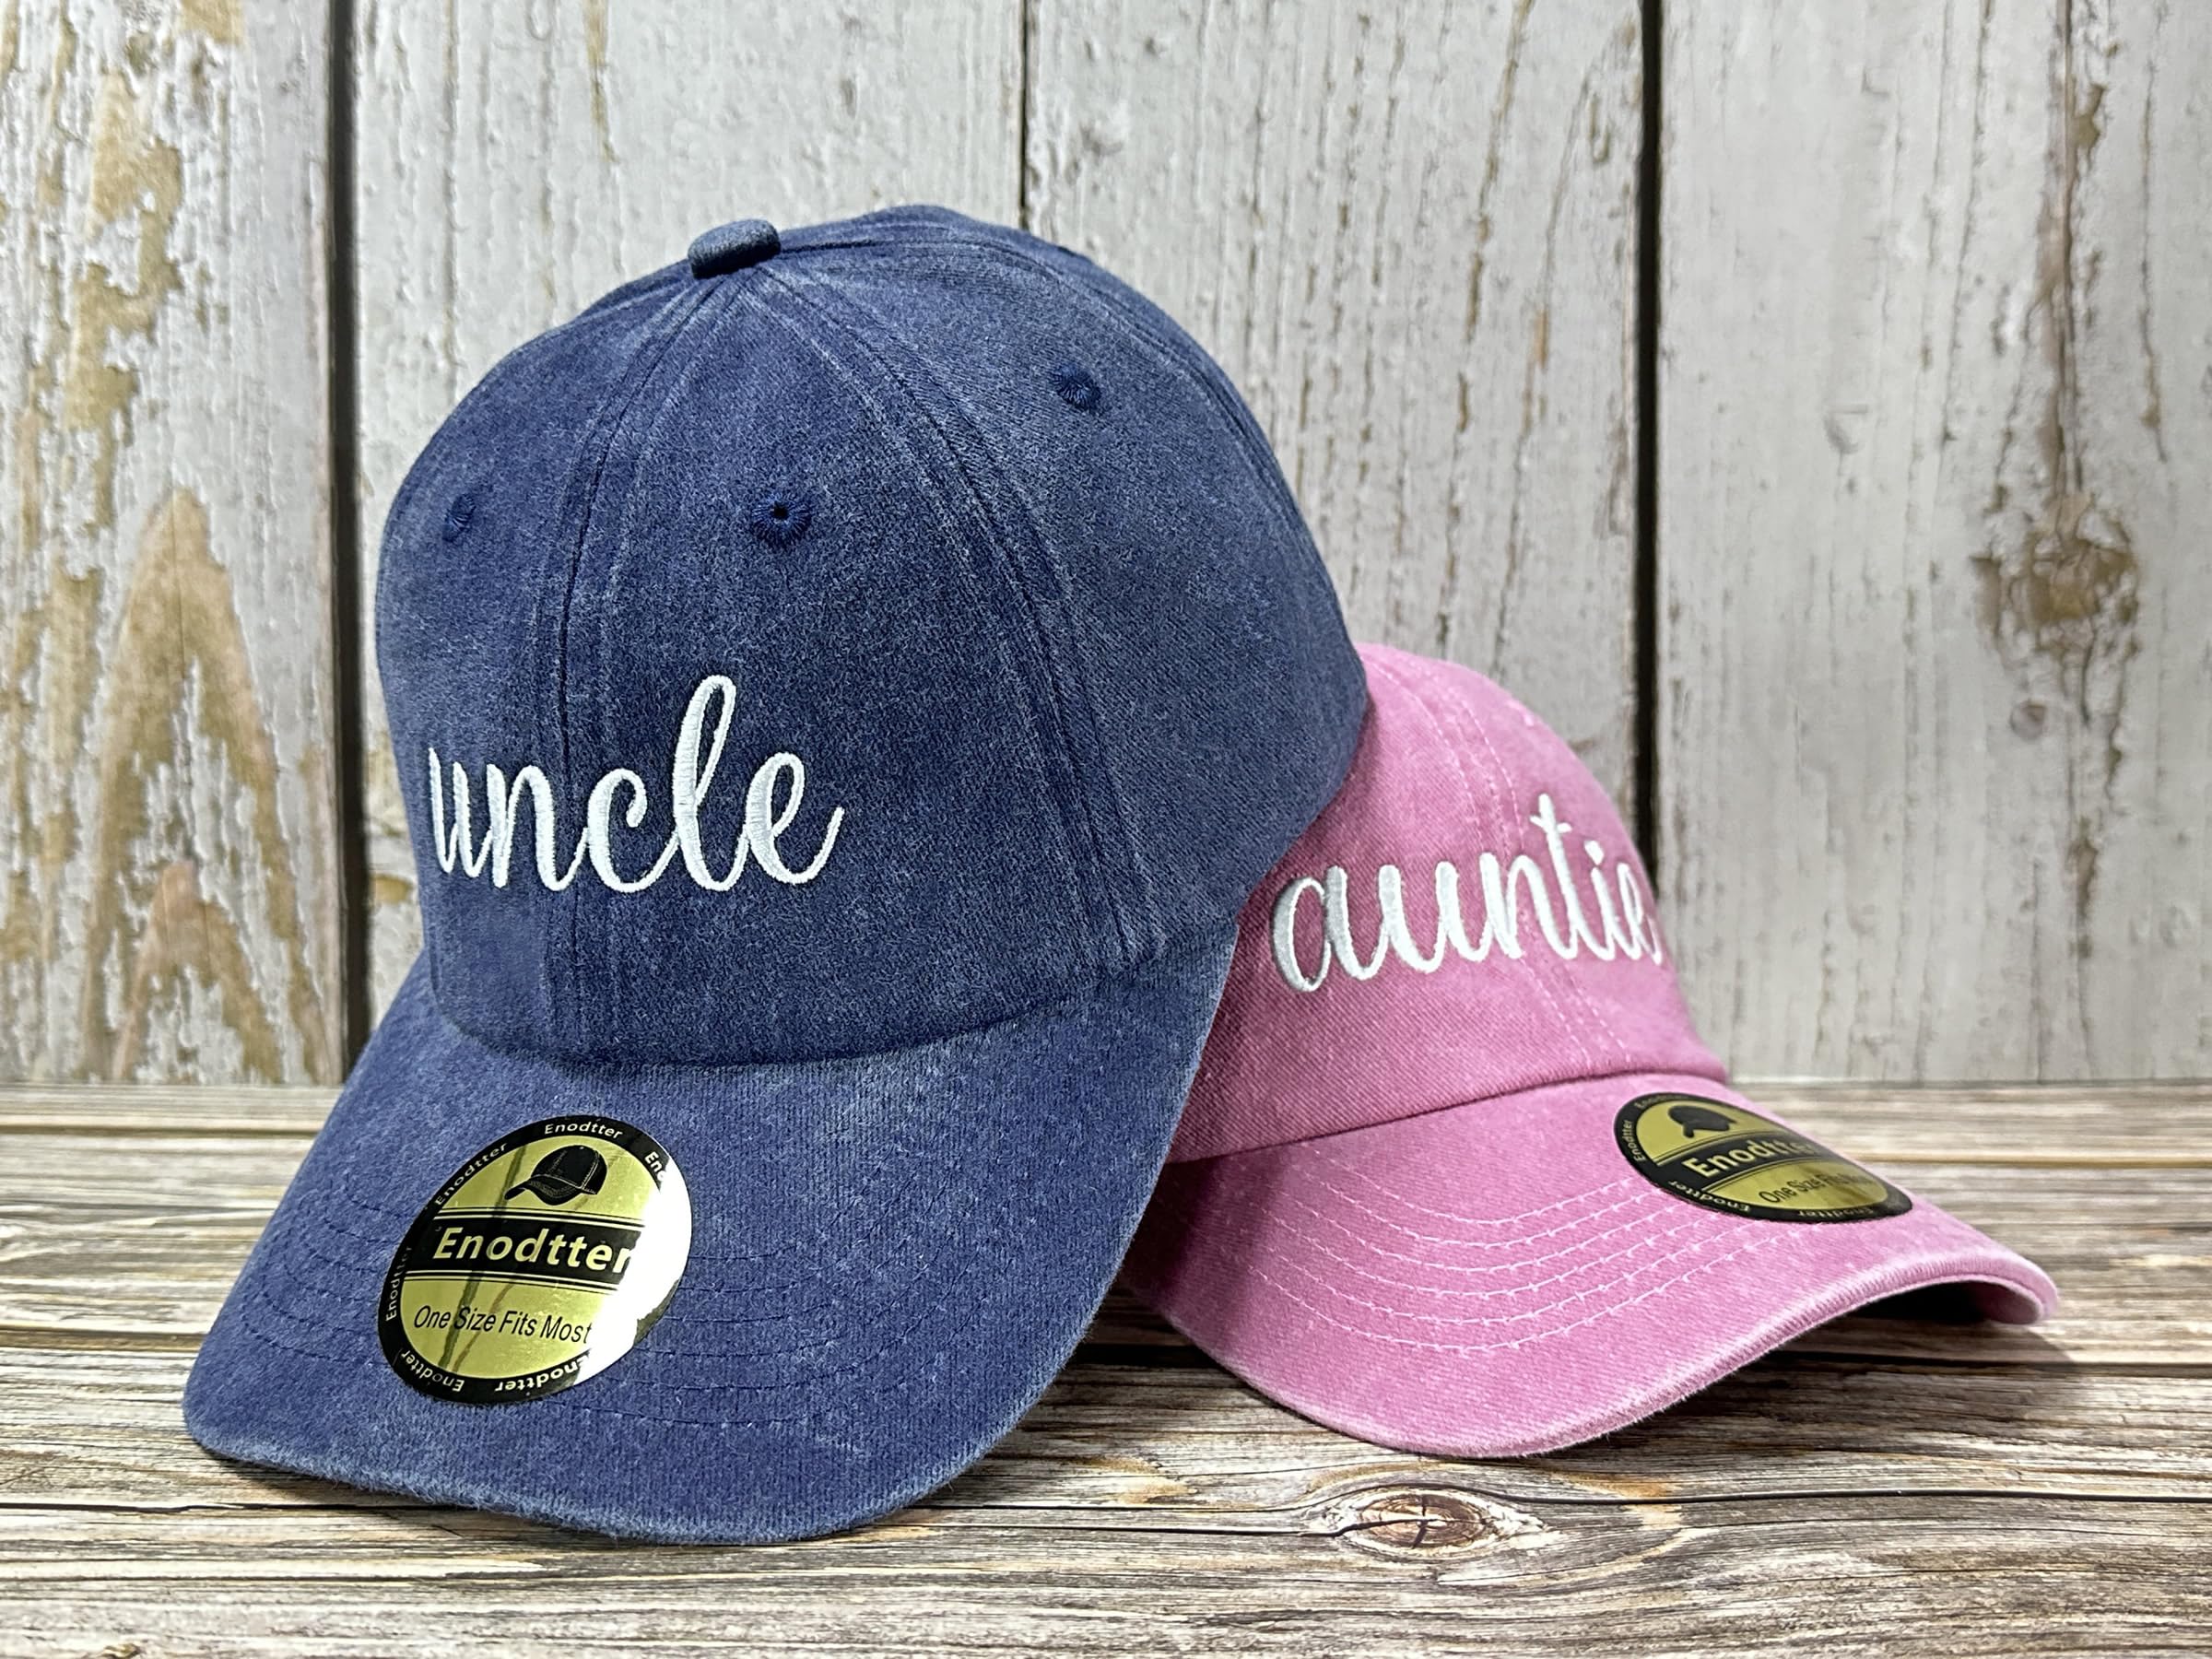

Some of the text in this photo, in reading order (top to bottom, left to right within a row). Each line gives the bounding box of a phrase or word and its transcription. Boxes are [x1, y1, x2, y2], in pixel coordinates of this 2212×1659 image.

[428, 675, 845, 892] uncle
[1272, 794, 1663, 992] auntie
[544, 1121, 623, 1140] Enodtter
[1621, 1120, 1647, 1162] Enodtter
[435, 1143, 507, 1206] Enodtter
[1668, 1180, 1751, 1212] Enodtter
[1759, 1186, 1797, 1204] One
[432, 1227, 632, 1274] Enodtter
[414, 1305, 593, 1345] One Size Fits Most
[400, 1349, 465, 1393] Enodtter
